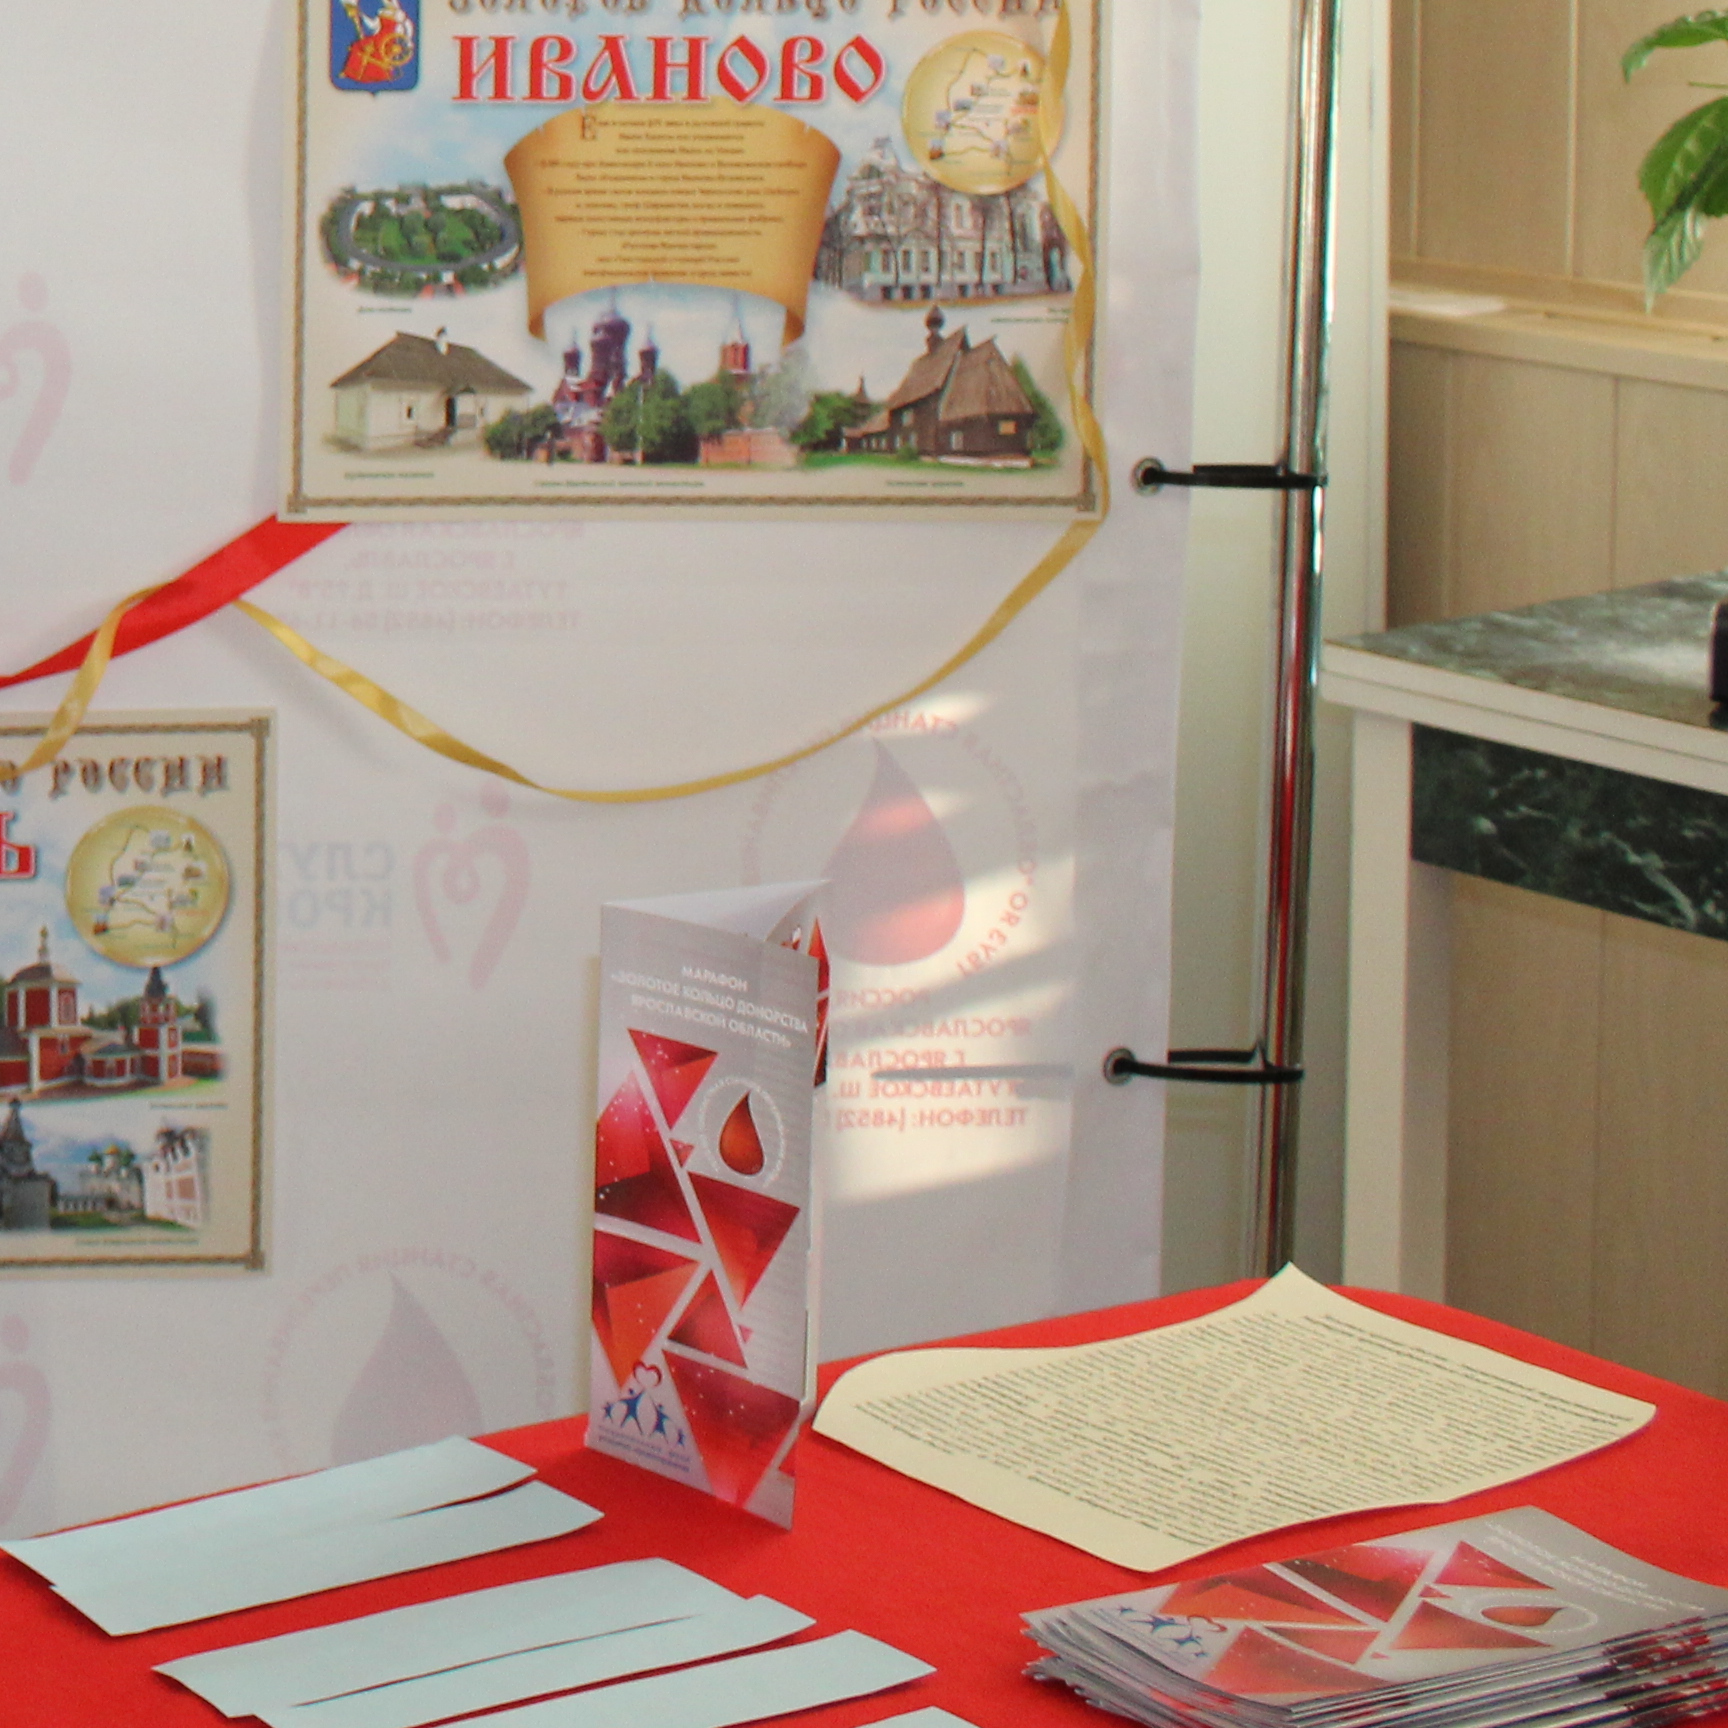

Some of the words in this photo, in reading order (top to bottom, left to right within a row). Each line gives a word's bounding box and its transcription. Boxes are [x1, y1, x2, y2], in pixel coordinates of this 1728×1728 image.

[452, 33, 887, 104] ИВАНОВО
[49, 755, 230, 799] РОССИИ
[681, 966, 748, 992] МАРАФОН
[631, 994, 727, 1029] ЯРОСЛАВСКОЙ
[682, 986, 735, 1010] КОЛЬЦО
[736, 1000, 809, 1034] ДОНОРСТВА
